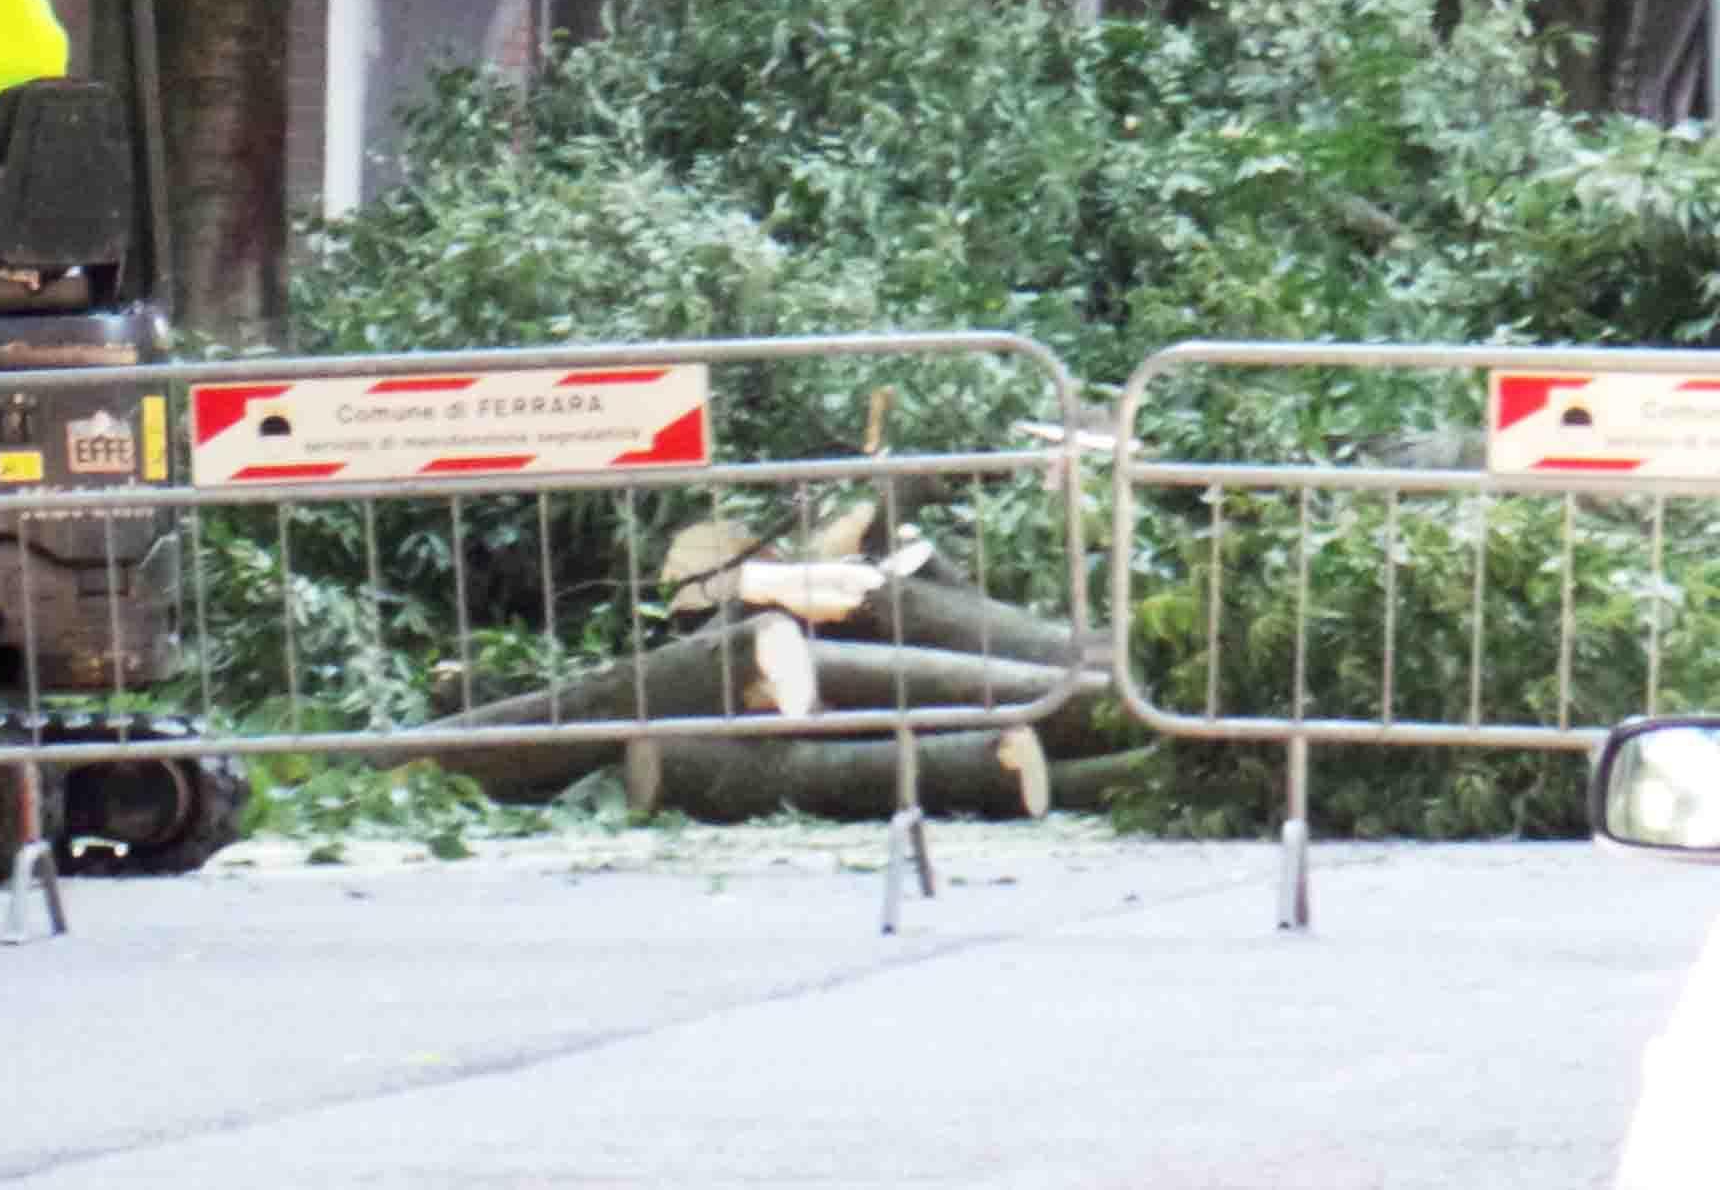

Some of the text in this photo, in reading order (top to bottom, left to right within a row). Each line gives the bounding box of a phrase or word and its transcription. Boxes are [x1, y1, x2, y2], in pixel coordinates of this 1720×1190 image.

[335, 395, 604, 425] Comune di FERRARA
